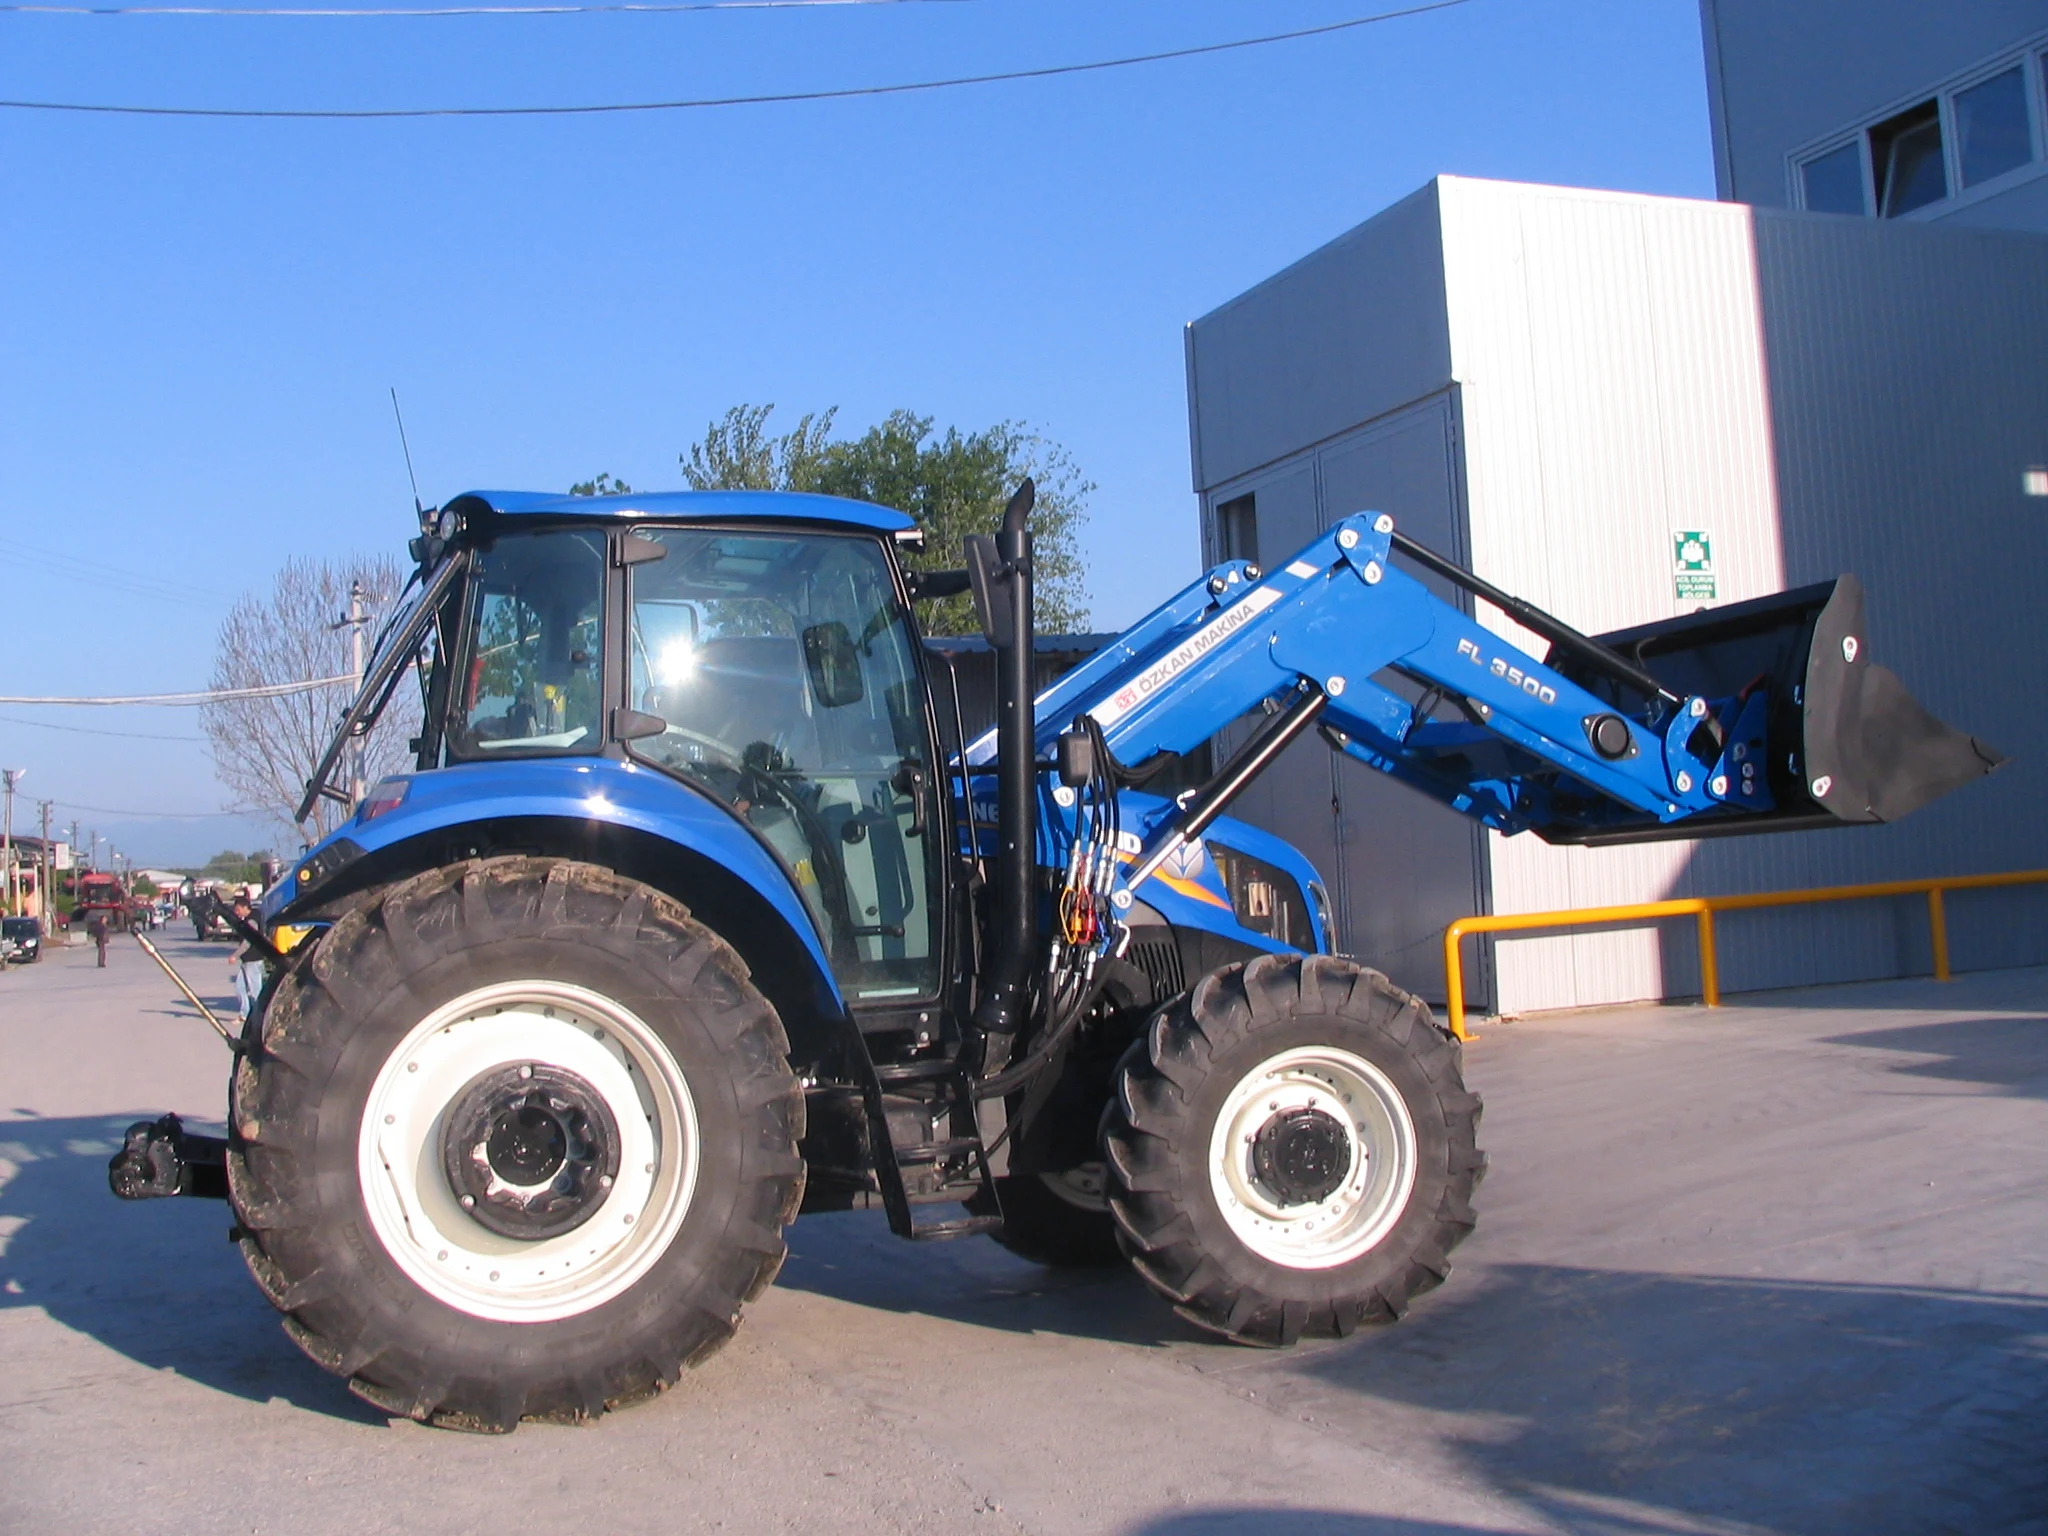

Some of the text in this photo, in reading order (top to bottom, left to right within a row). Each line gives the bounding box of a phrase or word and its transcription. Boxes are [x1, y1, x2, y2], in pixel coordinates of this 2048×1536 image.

[1138, 603, 1256, 693] ÖZKAN MAKİNA
[1456, 637, 1557, 705] FL 3500
[973, 801, 1000, 823] NE
